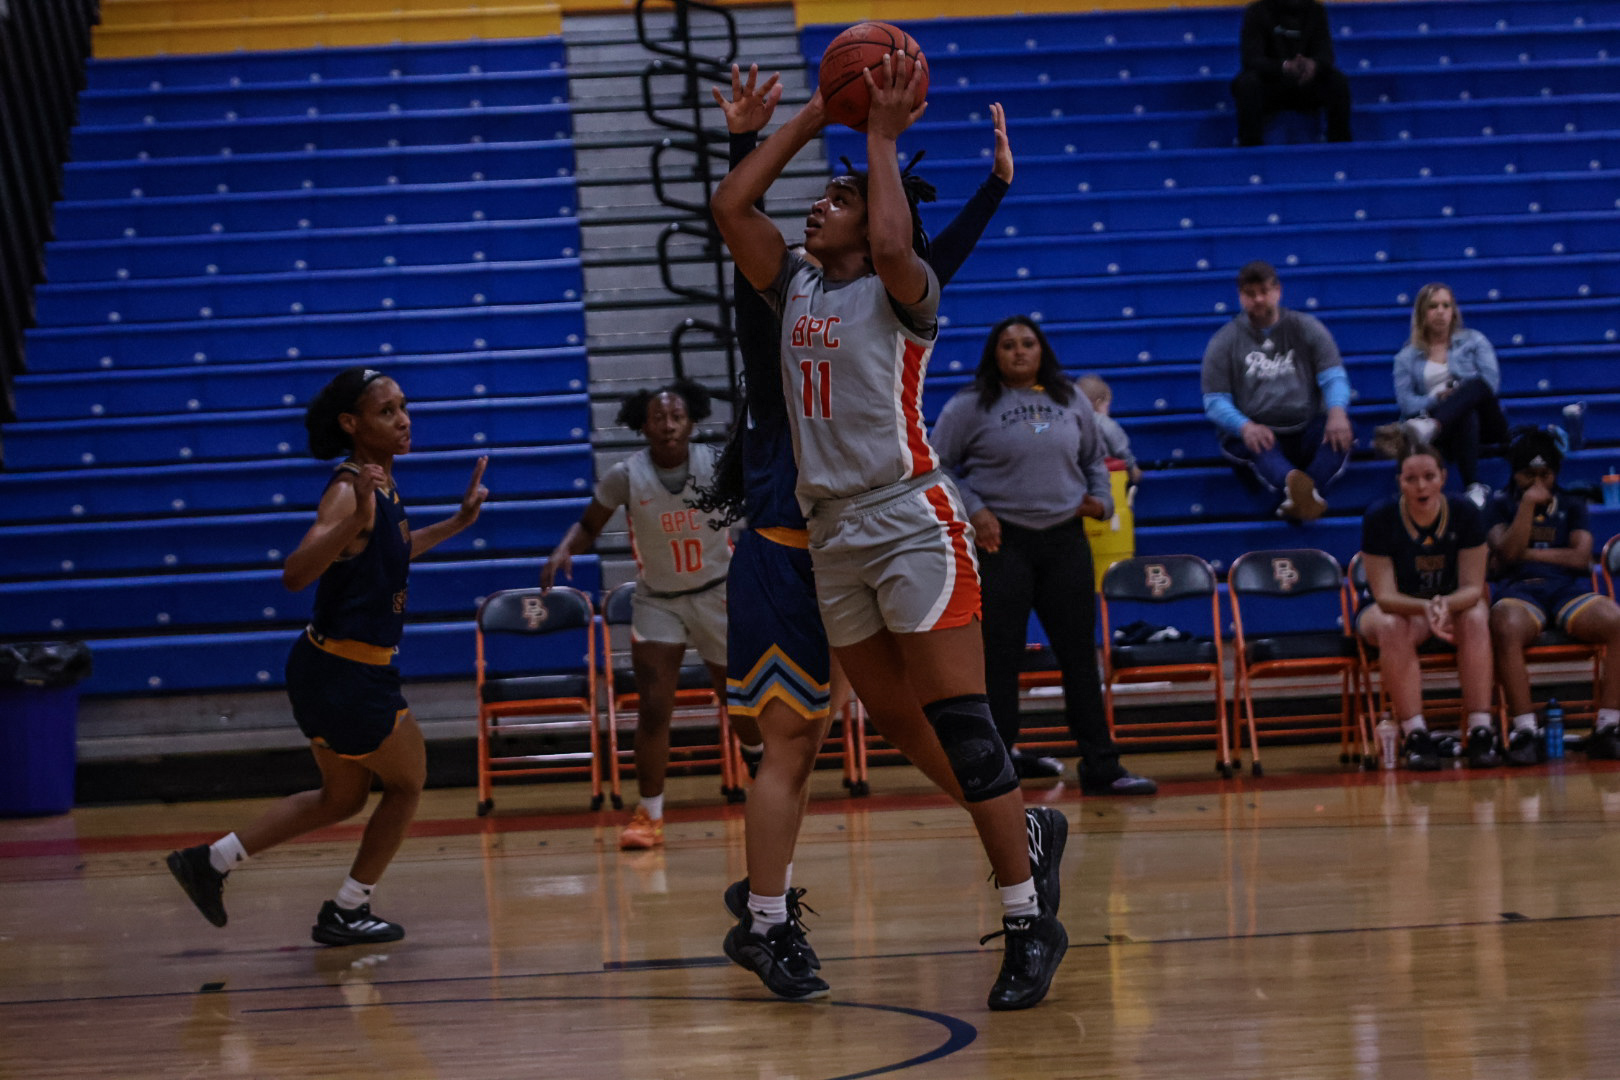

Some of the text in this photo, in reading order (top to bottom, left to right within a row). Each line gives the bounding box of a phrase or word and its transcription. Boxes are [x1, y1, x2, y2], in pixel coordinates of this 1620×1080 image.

[791, 315, 841, 349] BPC
[800, 359, 832, 419] 11
[661, 509, 701, 533] BPC
[670, 538, 703, 573] 10
